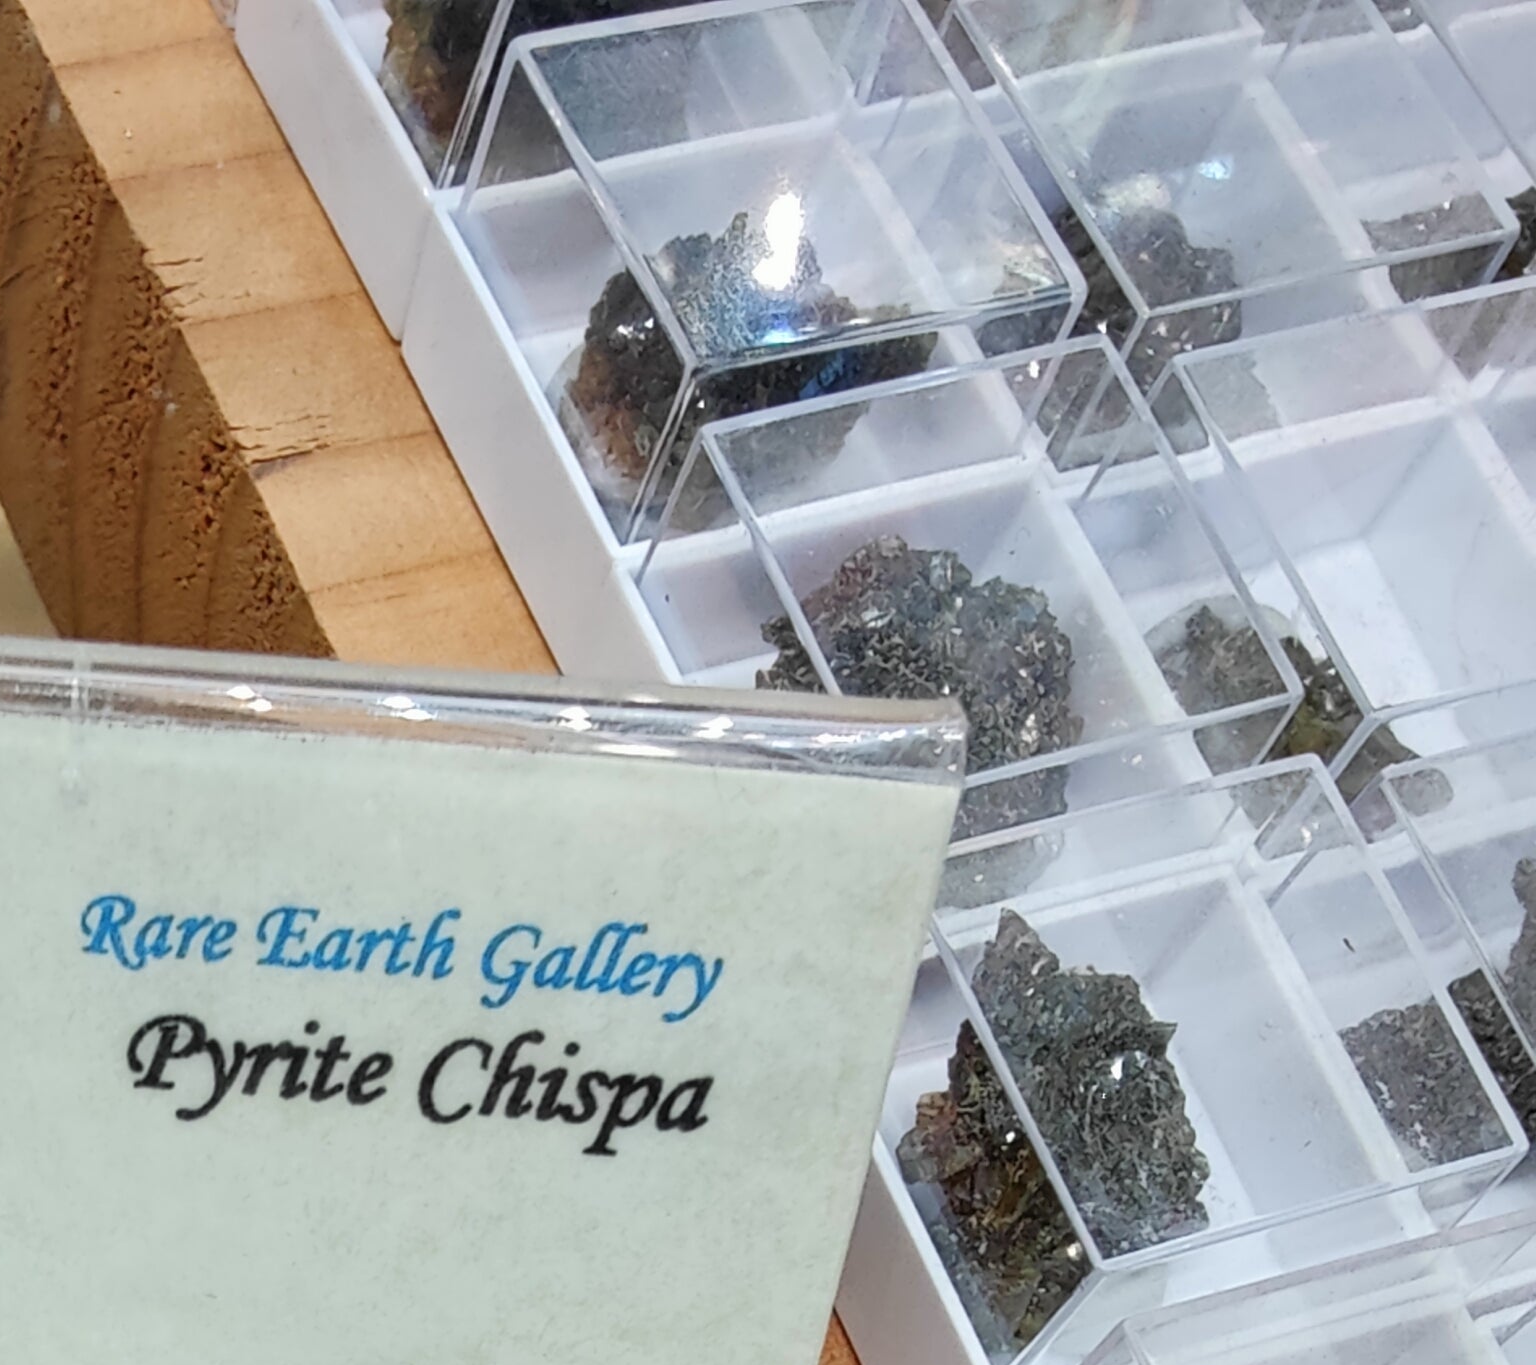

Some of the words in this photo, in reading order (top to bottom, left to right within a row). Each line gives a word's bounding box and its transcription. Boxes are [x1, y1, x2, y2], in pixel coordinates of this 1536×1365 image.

[79, 893, 239, 972] Rare
[254, 904, 463, 982] Earth
[479, 920, 725, 1025] Gallery
[125, 1012, 395, 1123] Pyrite
[416, 1028, 716, 1158] Chispa
